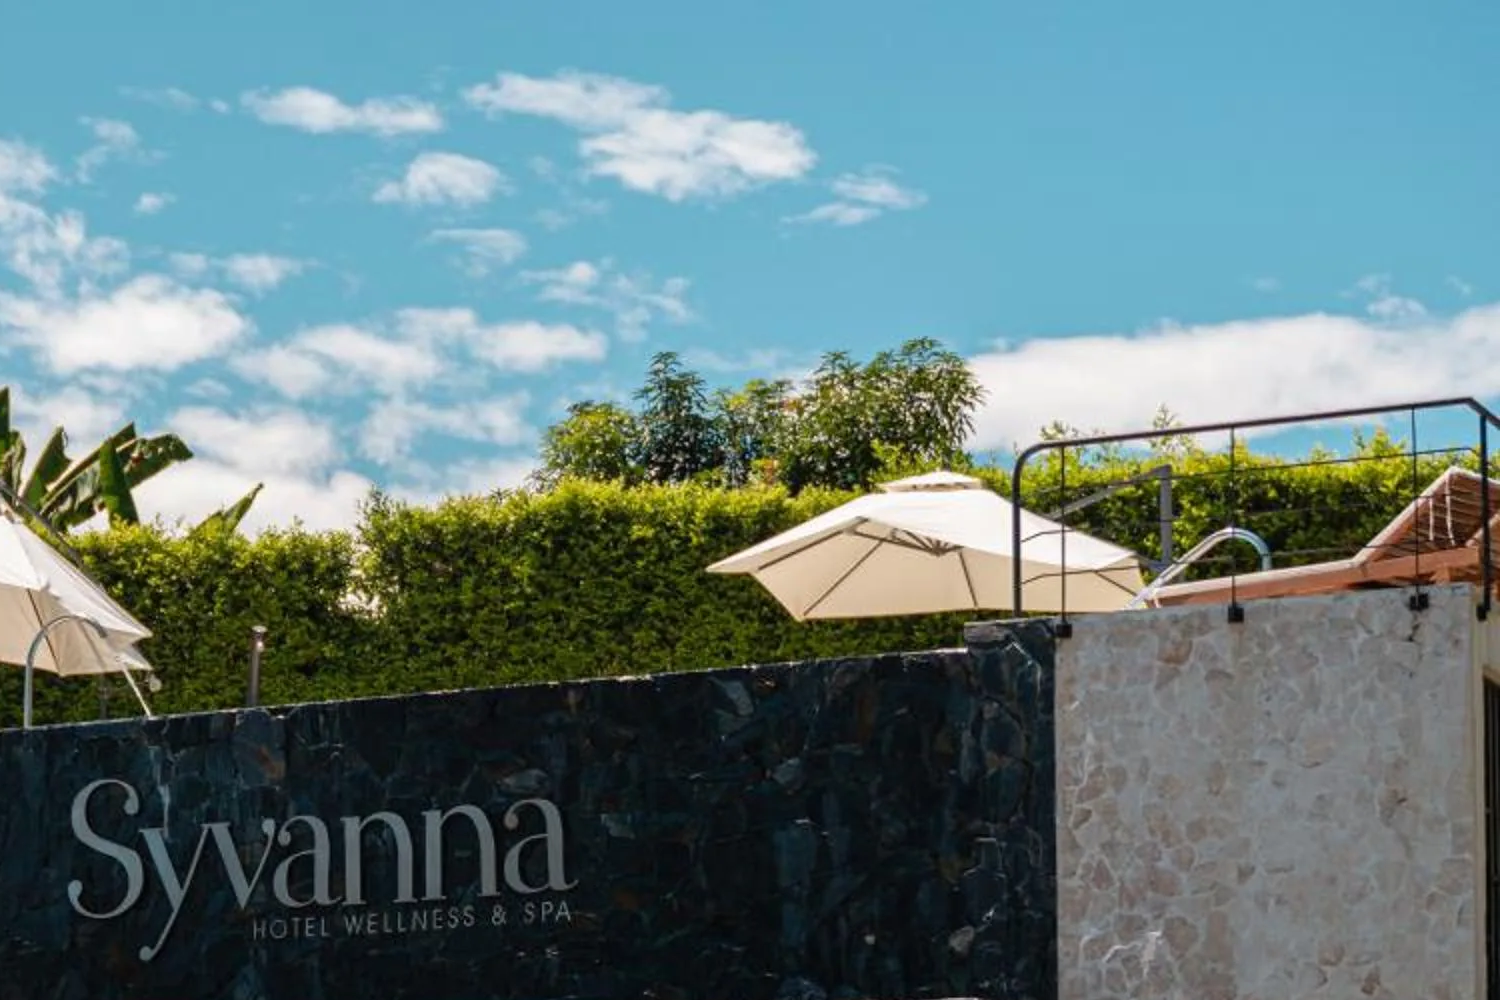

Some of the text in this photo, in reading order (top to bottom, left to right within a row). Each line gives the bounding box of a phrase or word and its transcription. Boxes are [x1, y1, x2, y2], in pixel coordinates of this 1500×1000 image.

[68, 779, 578, 960] Syvanna
[252, 901, 572, 941] HOTEL WELLNESS & SPA
